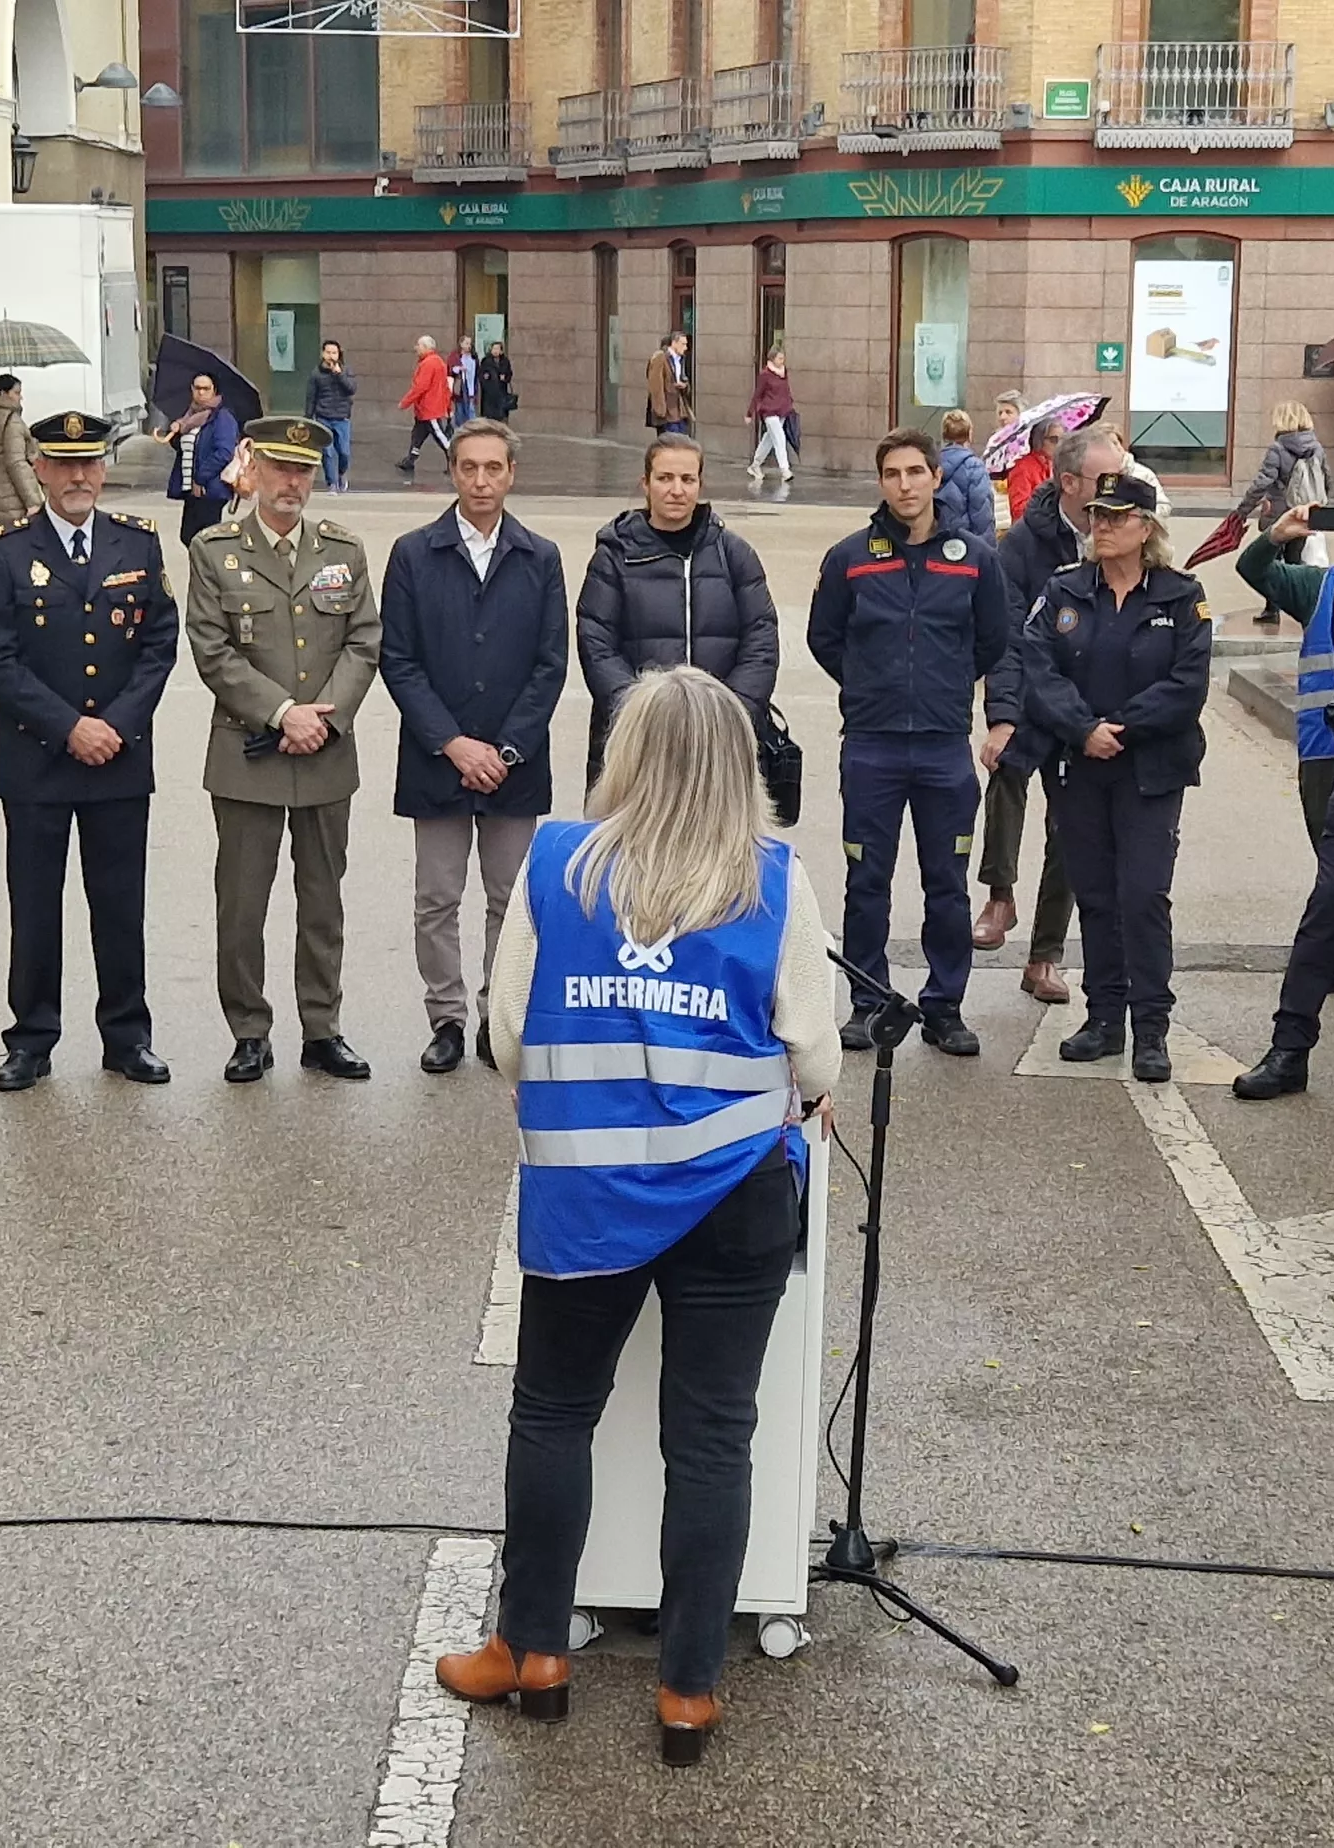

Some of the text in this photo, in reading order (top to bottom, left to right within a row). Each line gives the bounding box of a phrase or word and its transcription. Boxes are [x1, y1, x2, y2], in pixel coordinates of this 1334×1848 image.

[1159, 178, 1260, 193] CAJA RURAL
[1170, 194, 1249, 208] DE ARAGÓN
[564, 975, 728, 1022] ENFERMERA
